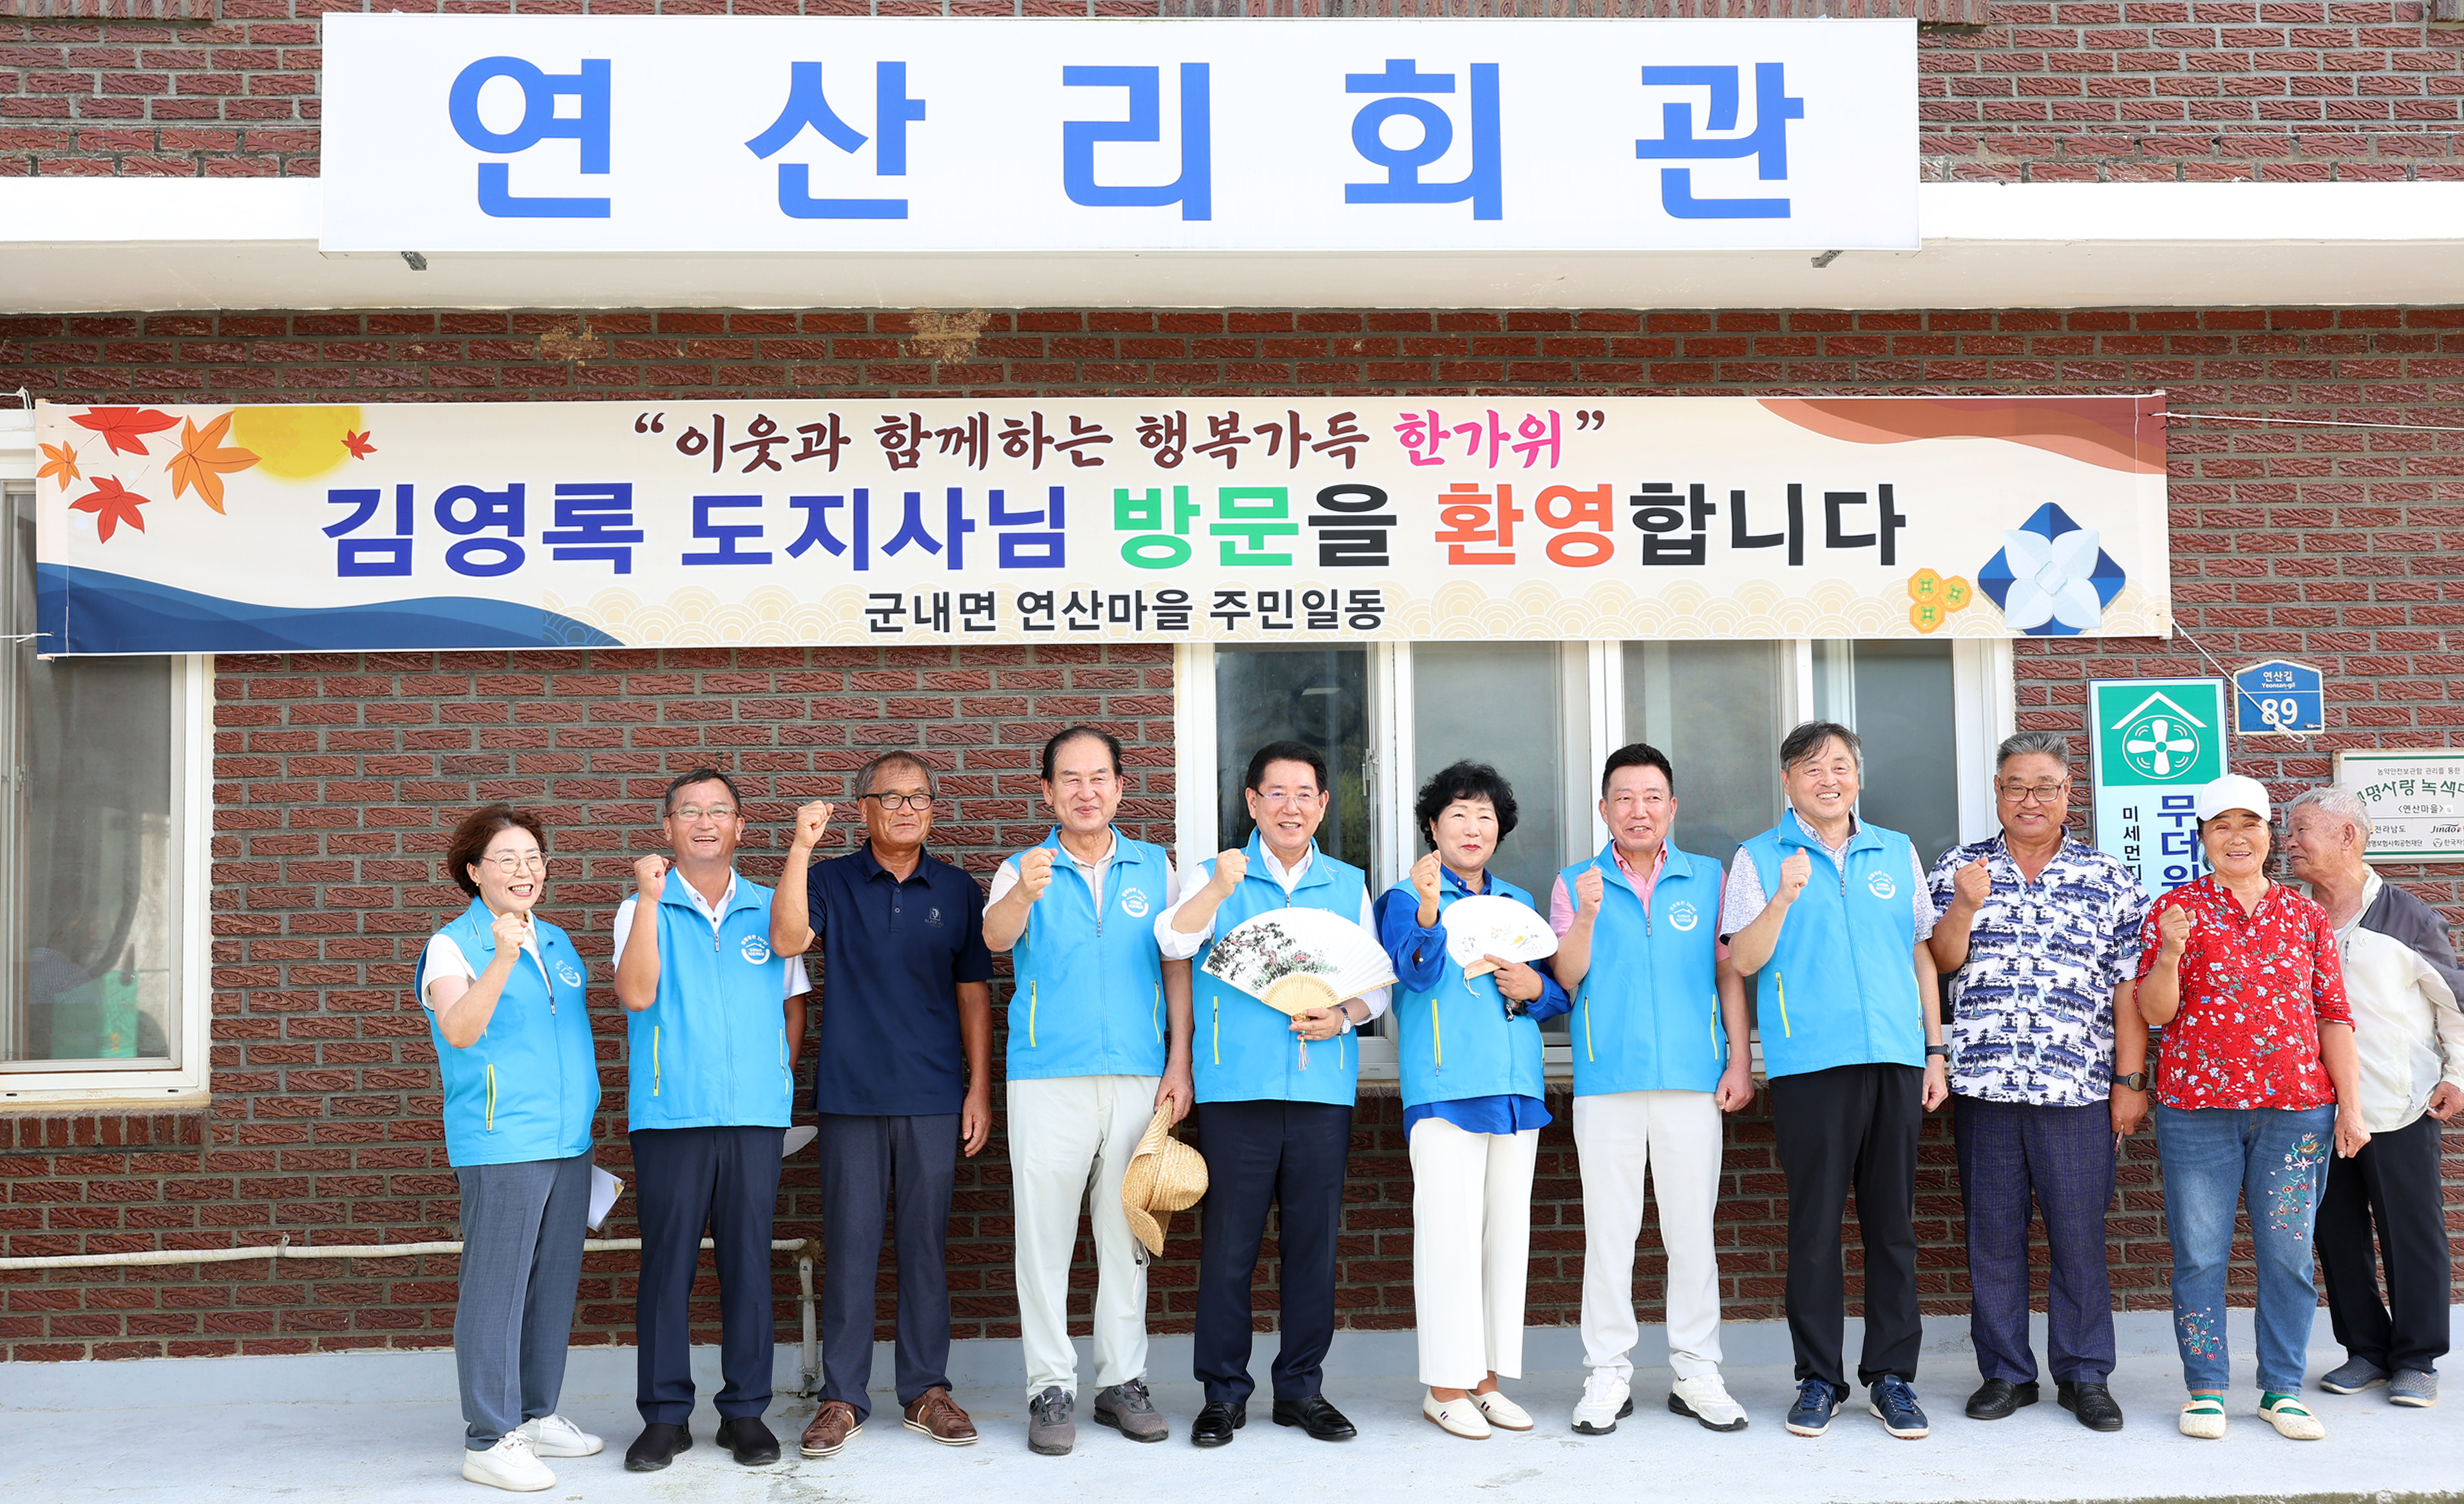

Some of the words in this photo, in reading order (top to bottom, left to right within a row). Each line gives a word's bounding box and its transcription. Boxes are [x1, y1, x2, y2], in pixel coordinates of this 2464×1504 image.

[874, 411, 1114, 471] 함께하는
[1135, 410, 1370, 469] 행복가득
[321, 483, 643, 577] 김영록
[682, 486, 1065, 571] 도지사님
[1114, 483, 1397, 569] 방문을
[1435, 482, 1906, 567] 환영합니다
[865, 591, 996, 633] 군내면
[1017, 590, 1193, 632] 연산마을
[1210, 589, 1385, 631] 주민일동
[2262, 671, 2293, 682] 연산길
[2261, 698, 2298, 725] 89
[2447, 766, 2461, 775] 통한
[2374, 825, 2406, 834] 전라남도
